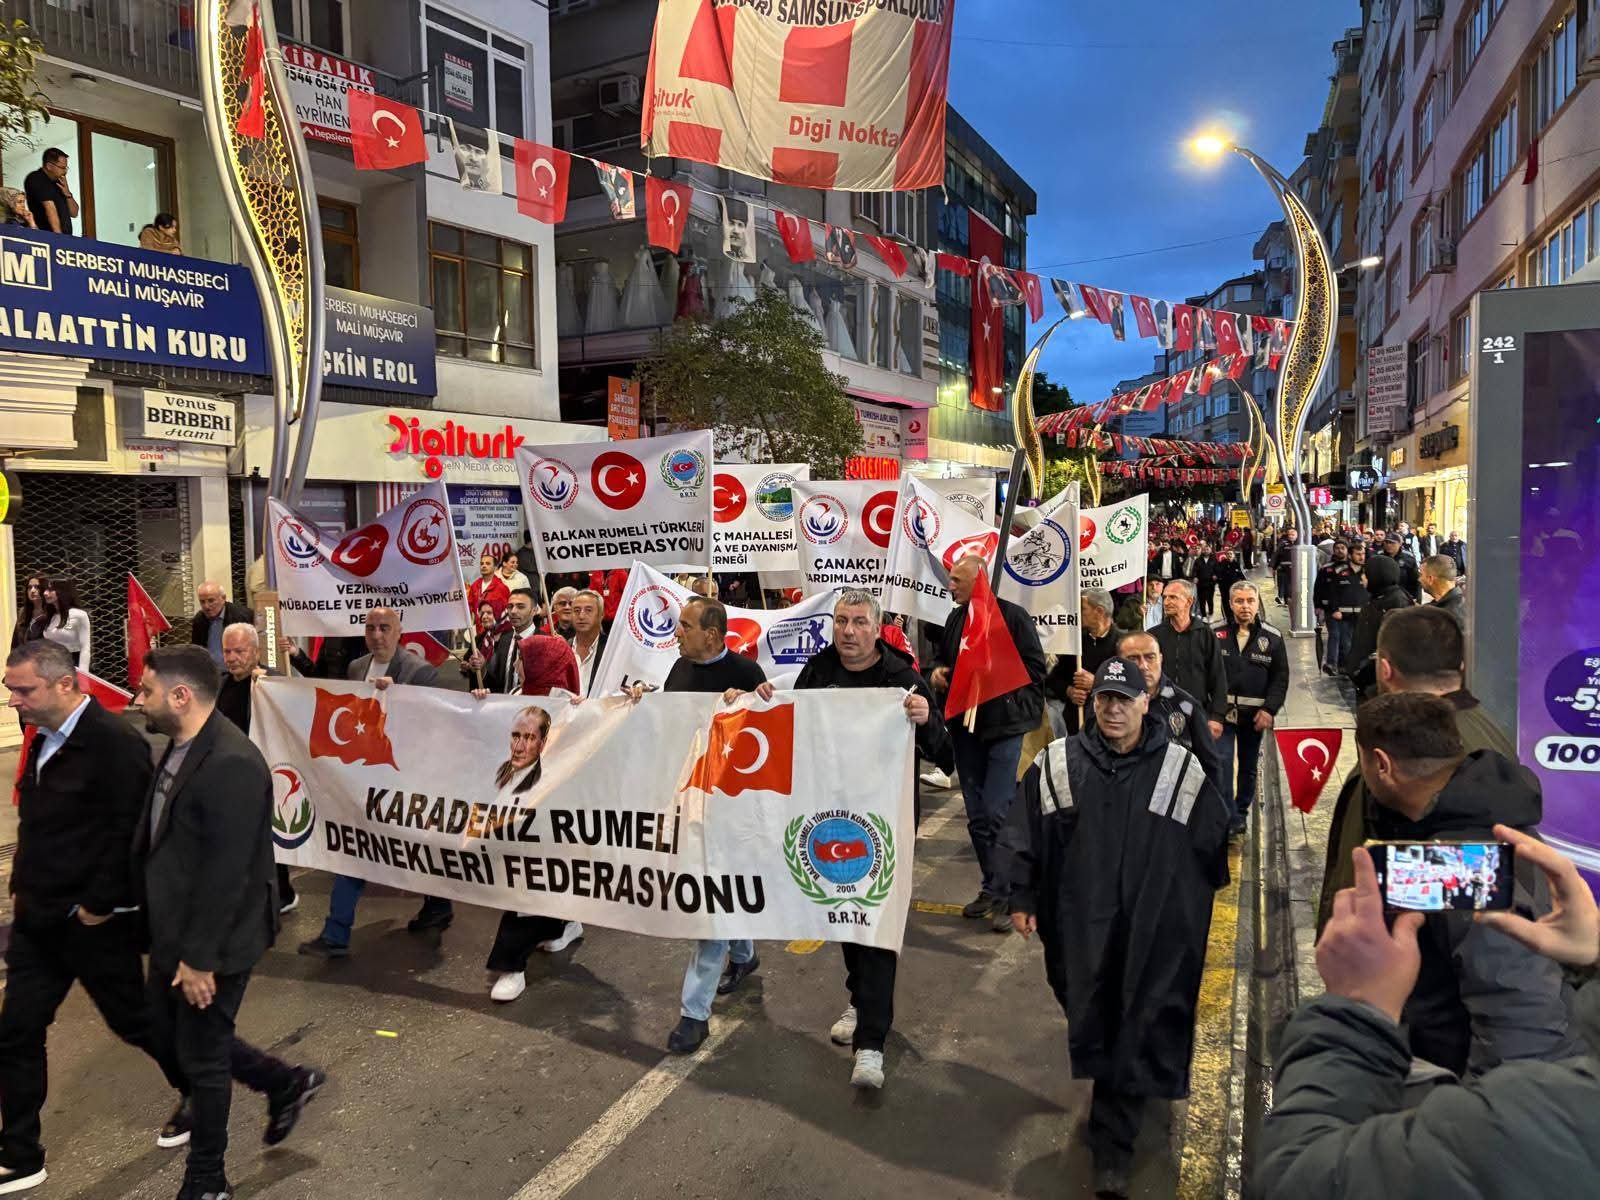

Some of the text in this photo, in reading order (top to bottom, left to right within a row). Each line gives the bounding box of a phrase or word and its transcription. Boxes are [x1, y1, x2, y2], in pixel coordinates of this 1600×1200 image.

[315, 92, 342, 111] HAN
[788, 115, 900, 149] Digi Nokta
[56, 249, 229, 292] SERBEST MUHASEBECİ
[88, 277, 205, 309] MALİ MÜŞAVİR
[360, 304, 417, 329] MUHASEBECİ
[0, 307, 247, 363] ALAATTİN KURU
[336, 318, 404, 343] MALİ MÜŞAVİR
[1483, 336, 1514, 349] 242
[1493, 352, 1504, 364] 1
[373, 358, 418, 385] EROL
[146, 407, 232, 431] BERBERİ
[463, 463, 490, 472] MEDIA
[542, 520, 705, 542] BALKAN RUMELİ TÜRKLERİ
[724, 529, 793, 541] MAHALLESİ
[545, 537, 704, 560] KONFEDERASYONU
[814, 559, 879, 571] ÇANAKÇI
[1081, 559, 1127, 577] ÜRKLERİ
[885, 574, 947, 599] MÜBADELE
[279, 598, 341, 611] MÜBADELE
[345, 599, 362, 610] VE
[365, 598, 416, 610] BALKAN
[365, 787, 681, 855] KARADENİZ RUMELİ
[811, 809, 850, 824] TÜRKLERİ
[850, 813, 882, 881] KONFEDERASYONU
[325, 820, 767, 914] DERNEKLERİ FEDERASYONU
[836, 885, 857, 893] 2005
[828, 911, 871, 926] B.R.T.K.
